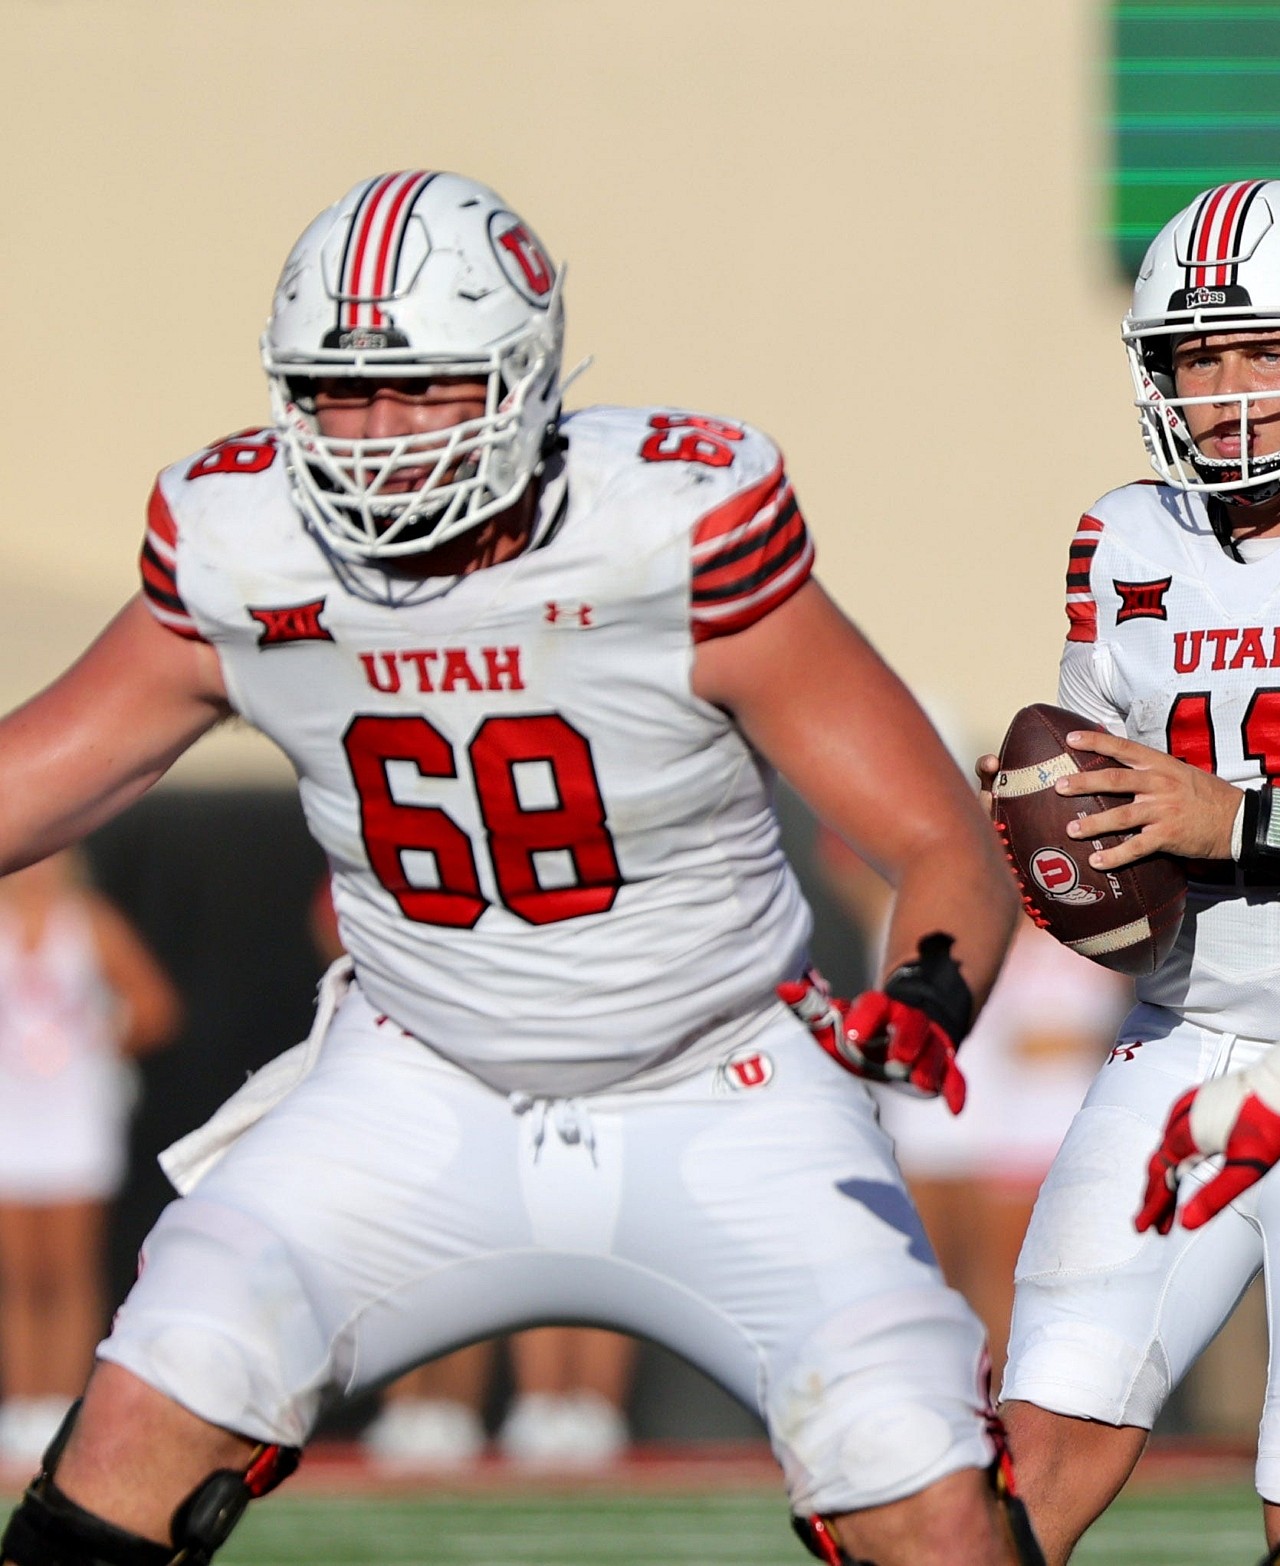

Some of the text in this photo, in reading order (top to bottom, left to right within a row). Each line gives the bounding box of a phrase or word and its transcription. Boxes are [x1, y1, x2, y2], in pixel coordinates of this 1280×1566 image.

[501, 228, 550, 294] U
[359, 647, 526, 694] UTAH
[342, 713, 624, 930] 68
[1036, 856, 1073, 889] U
[732, 1055, 765, 1088] U
